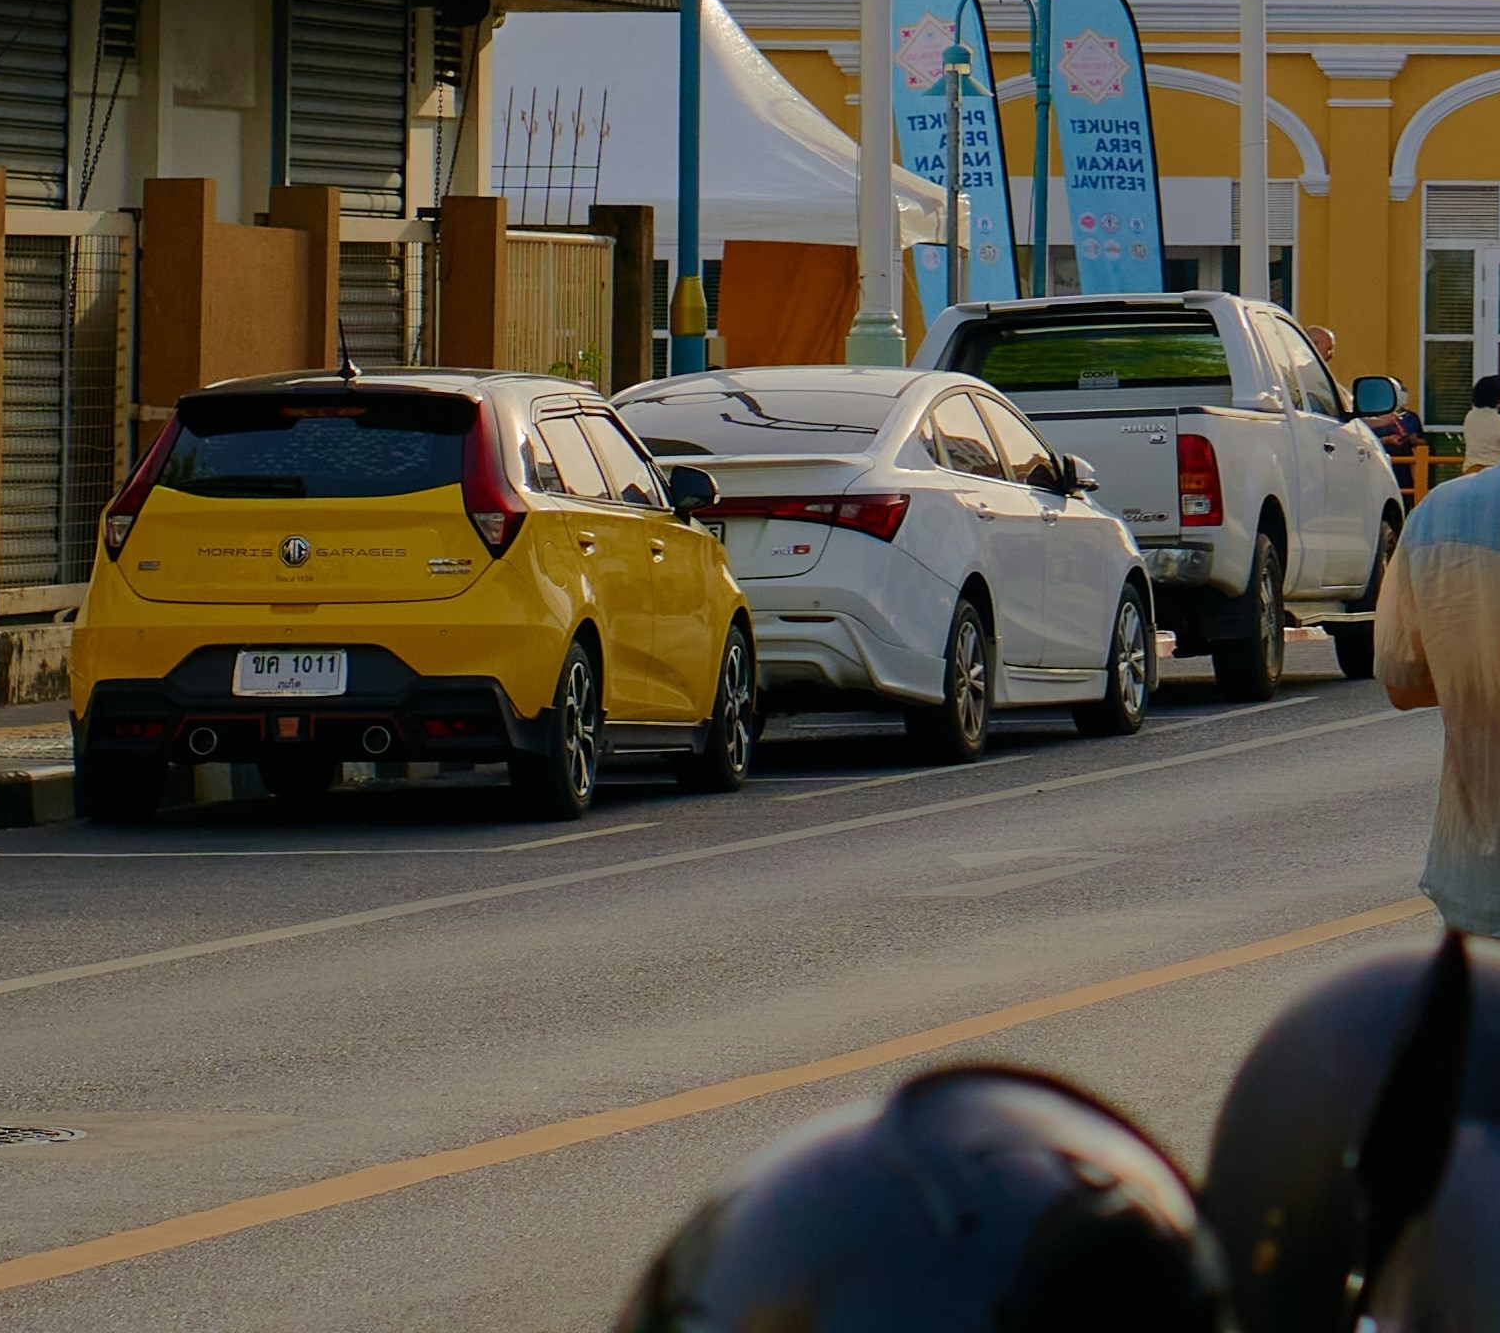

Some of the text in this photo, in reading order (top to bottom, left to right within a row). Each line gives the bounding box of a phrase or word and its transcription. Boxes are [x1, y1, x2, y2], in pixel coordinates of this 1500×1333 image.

[1120, 423, 1168, 433] HILUX
[198, 547, 273, 558] MORRIS
[281, 538, 309, 565] MG
[316, 547, 407, 558] GARAGES
[253, 655, 335, 674] ขค 1011
